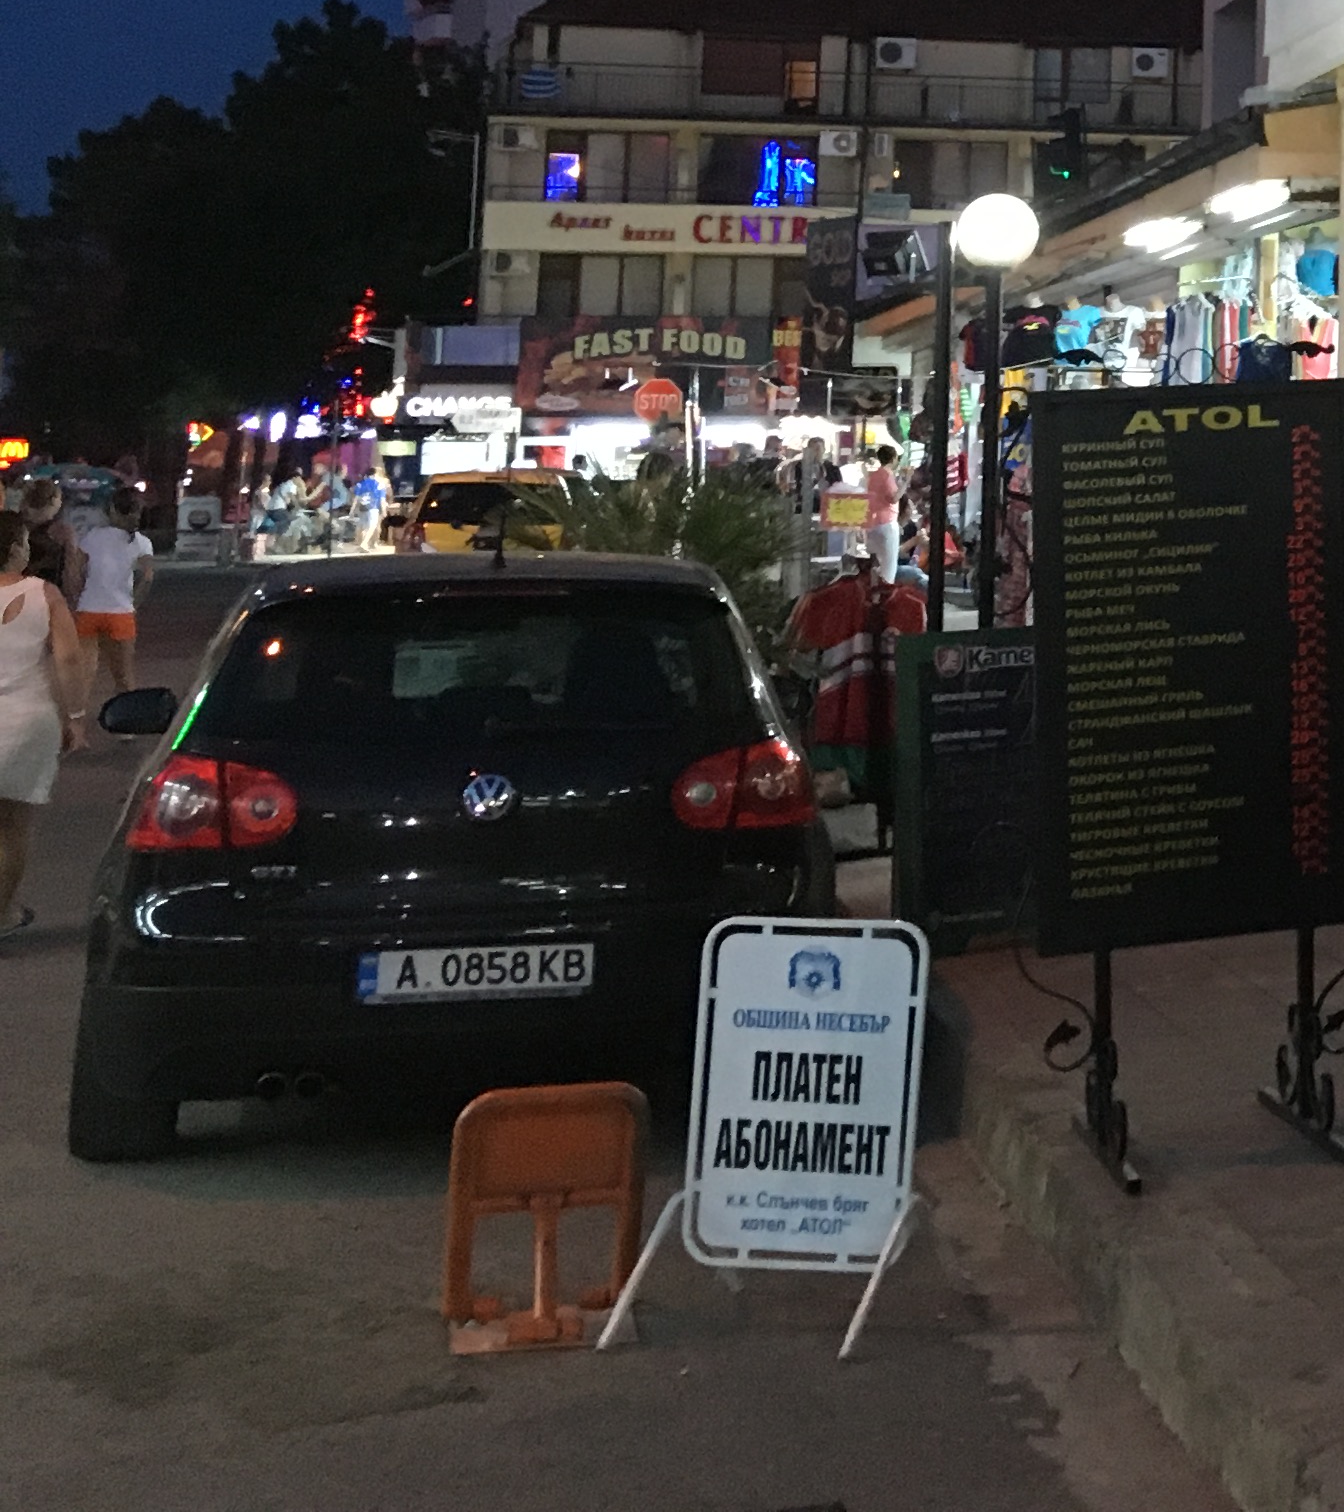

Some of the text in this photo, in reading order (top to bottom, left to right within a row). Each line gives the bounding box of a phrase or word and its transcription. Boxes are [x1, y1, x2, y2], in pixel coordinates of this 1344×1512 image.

[574, 328, 747, 361] FAST FOOD
[406, 395, 513, 417] CHANGE
[638, 393, 679, 410] STOP
[1123, 403, 1280, 435] ATOL
[1139, 437, 1165, 450] СУП
[1063, 455, 1167, 472] ТОМАТНЫЙ СУП
[1148, 473, 1174, 486] СУП
[1134, 490, 1176, 504] САЛАТ
[733, 1008, 891, 1034] ОБЩИНА НЕСЕБЪР
[751, 1050, 864, 1106] ПЛАТЕН
[713, 1117, 892, 1177] АБОНАМЕНТ
[756, 1190, 828, 1212] Слънчев
[832, 1193, 869, 1214] бряг
[740, 1217, 786, 1233] хотел
